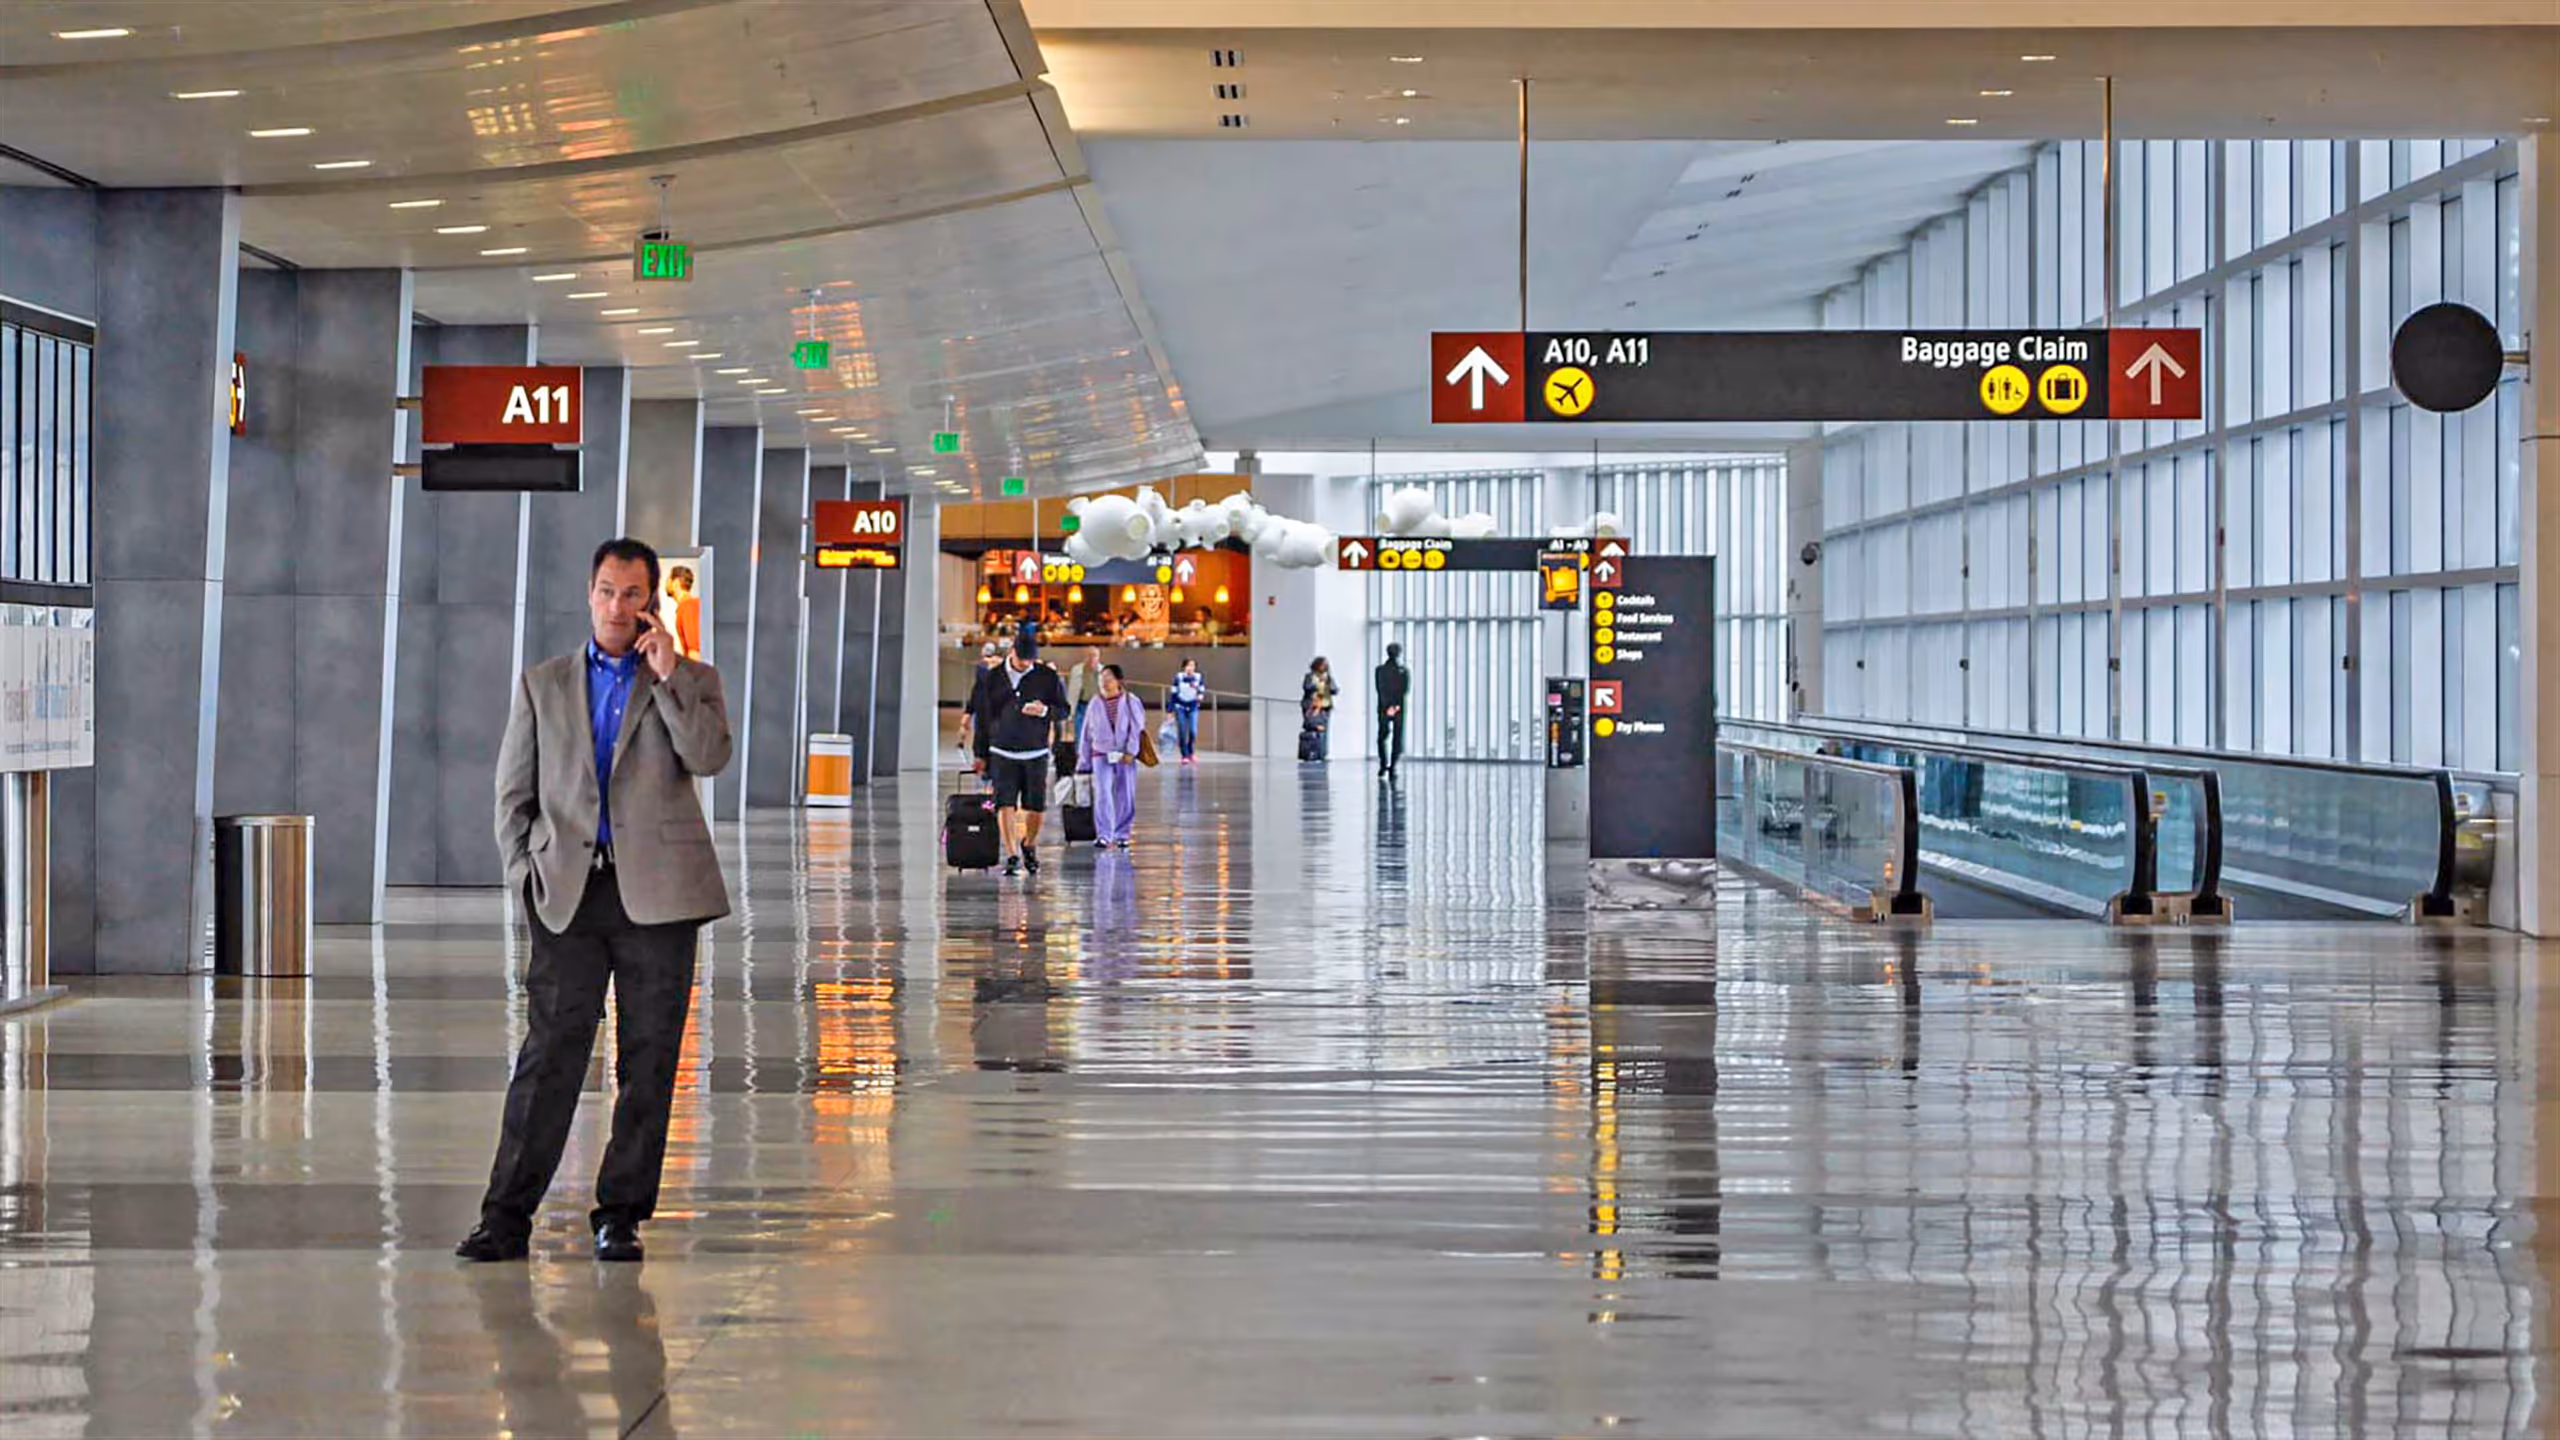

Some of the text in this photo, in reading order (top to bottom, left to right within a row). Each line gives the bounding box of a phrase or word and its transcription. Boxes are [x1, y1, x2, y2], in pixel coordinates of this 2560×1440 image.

[642, 243, 687, 277] EXIT
[1543, 338, 1648, 367] A10, A11
[1902, 336, 2088, 367] Baggage Claim
[502, 385, 569, 424] A11
[853, 510, 897, 534] A10
